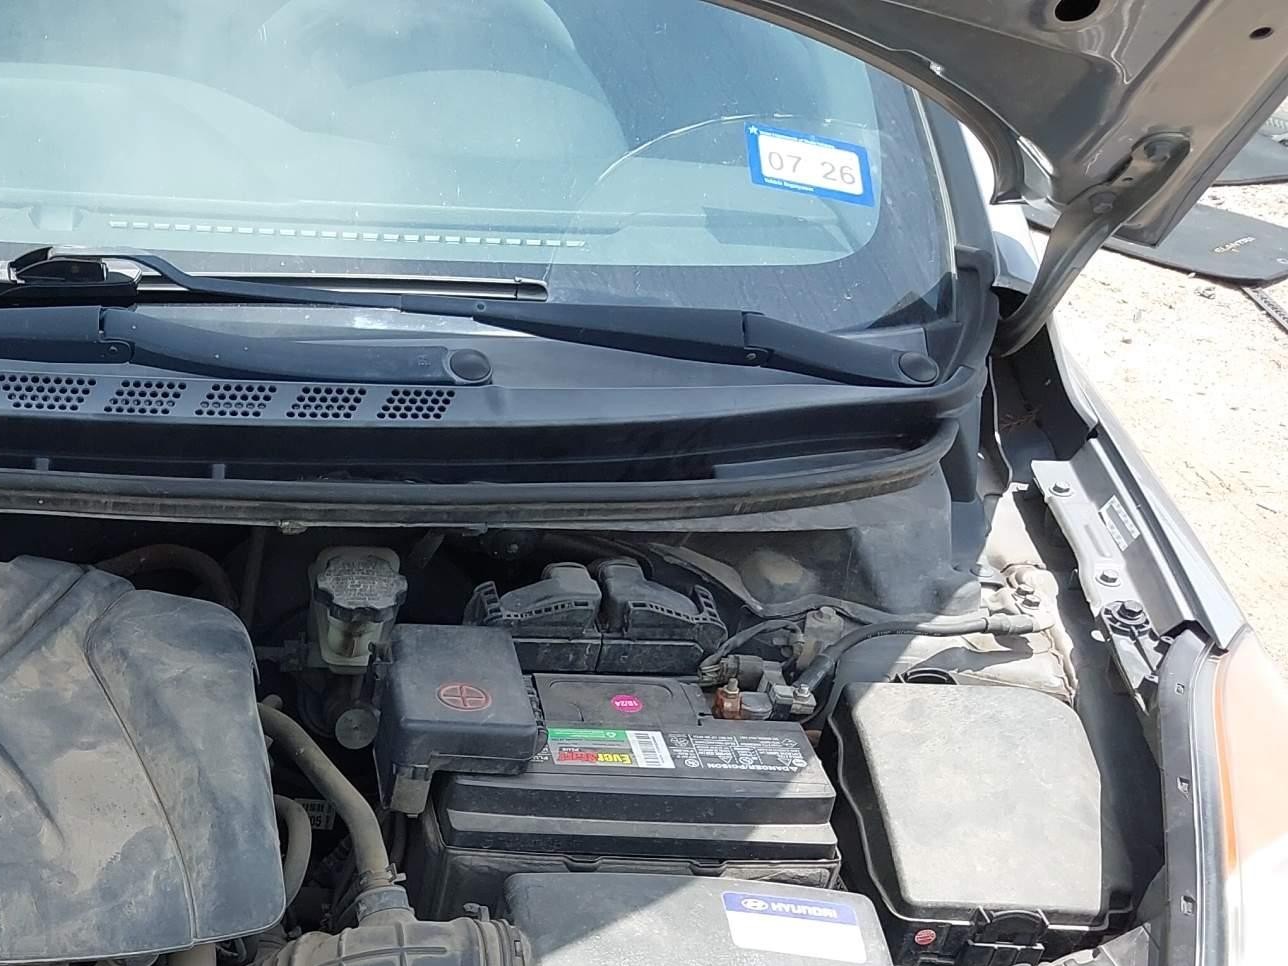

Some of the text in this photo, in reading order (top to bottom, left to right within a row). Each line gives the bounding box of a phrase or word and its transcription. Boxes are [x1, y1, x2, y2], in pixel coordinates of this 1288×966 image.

[767, 151, 856, 185] 07 26
[770, 903, 837, 918] HYUNDAI
